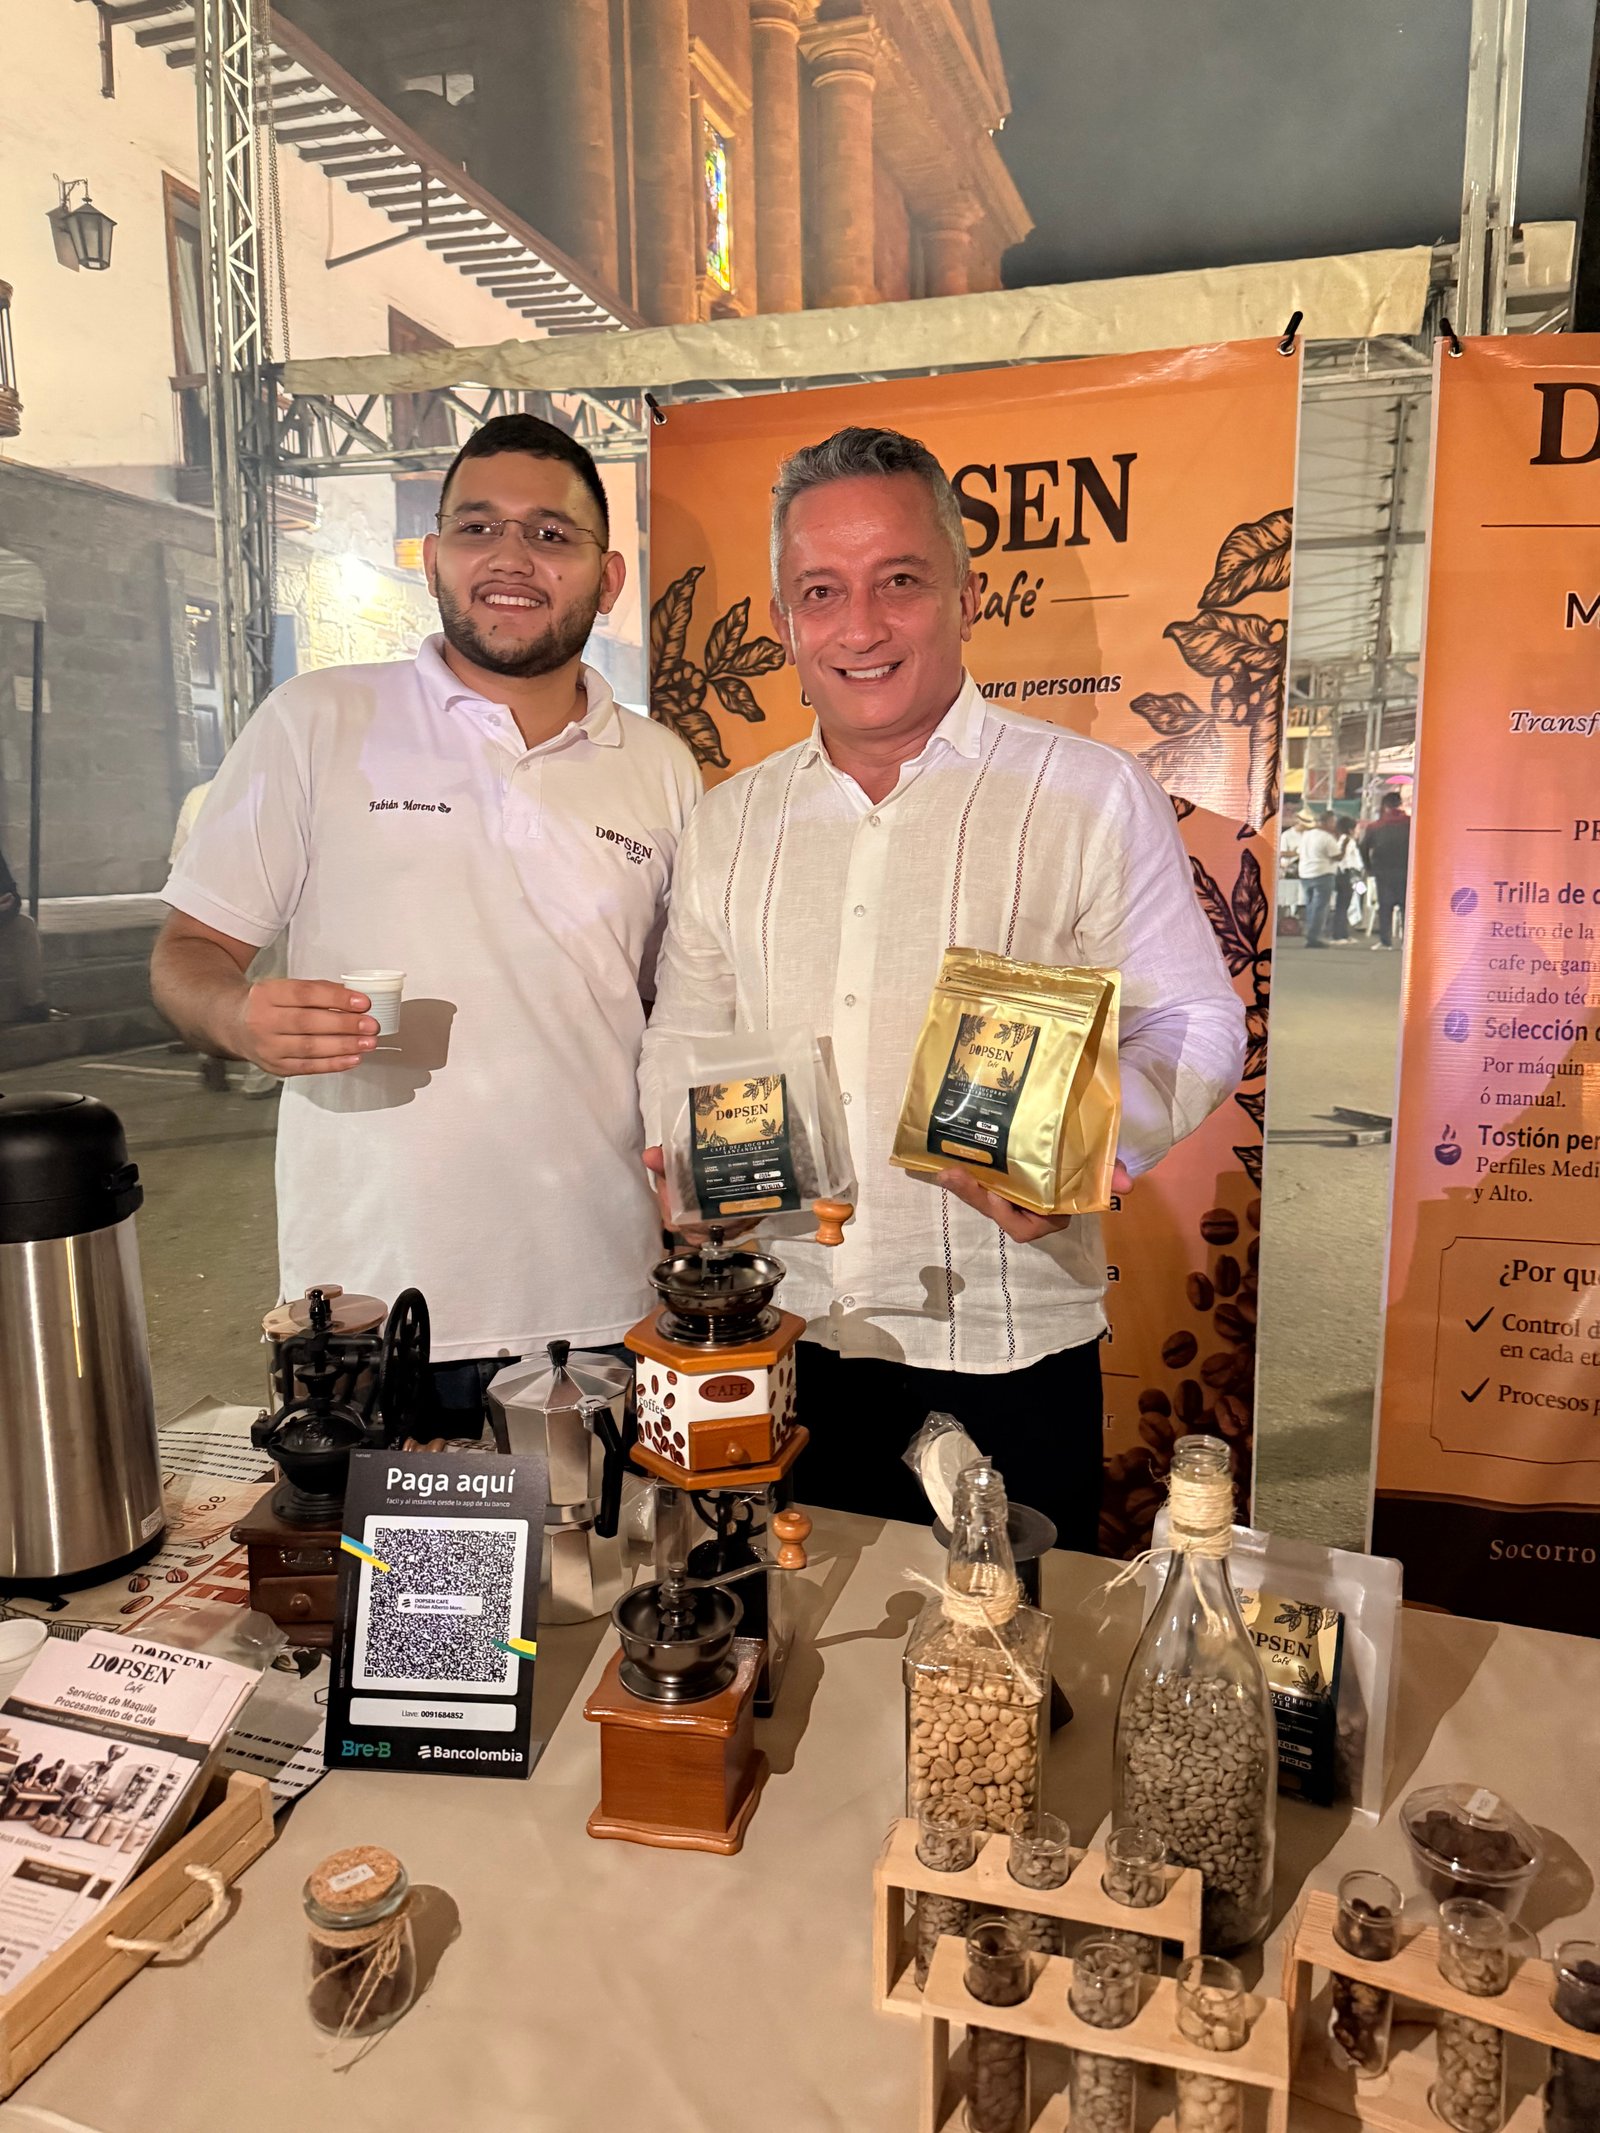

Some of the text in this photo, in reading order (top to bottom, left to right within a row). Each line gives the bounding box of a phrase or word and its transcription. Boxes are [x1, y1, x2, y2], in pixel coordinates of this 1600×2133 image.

[1022, 675, 1122, 702] personas
[369, 799, 436, 812] Fabián Moreno
[595, 825, 653, 859] DOPSEN
[626, 851, 644, 865] Café
[1494, 881, 1550, 904] Trilla
[1558, 882, 1585, 904] de
[1491, 921, 1594, 939] Retiro de la
[1487, 986, 1559, 1005] cuidado
[1484, 1017, 1588, 1041] Selección
[969, 1043, 1014, 1063] DOPSEN
[1482, 1056, 1514, 1073] Por
[1480, 1086, 1566, 1108] ó manual.
[716, 1103, 769, 1121] DOPSEN
[744, 1139, 776, 1148] SOCORRO
[1478, 1124, 1560, 1149] Tostión
[1475, 1156, 1600, 1178] Perfiles Medi
[1473, 1184, 1533, 1204] y Alto.
[1500, 1259, 1556, 1287] ¿Por
[1502, 1313, 1580, 1338] Control
[1500, 1344, 1523, 1359] en
[1529, 1344, 1574, 1364] cada
[705, 1382, 748, 1398] CAFE
[1498, 1384, 1589, 1412] Procesos
[639, 1397, 665, 1416] coffee
[386, 1467, 516, 1499] Paga aquí
[437, 1499, 455, 1507] desde
[1489, 1539, 1597, 1564] Socorro
[88, 1652, 175, 1685] DOPSEN
[1271, 1653, 1291, 1666] Café
[124, 1681, 146, 1694] Café
[66, 1686, 158, 1715] Servicios de Maquila
[54, 1696, 156, 1727] Procesamiento de Café
[401, 1710, 464, 1720] Llave: 0091684852
[341, 1740, 392, 1758] Bre-B
[433, 1745, 524, 1763] Bancolombia
